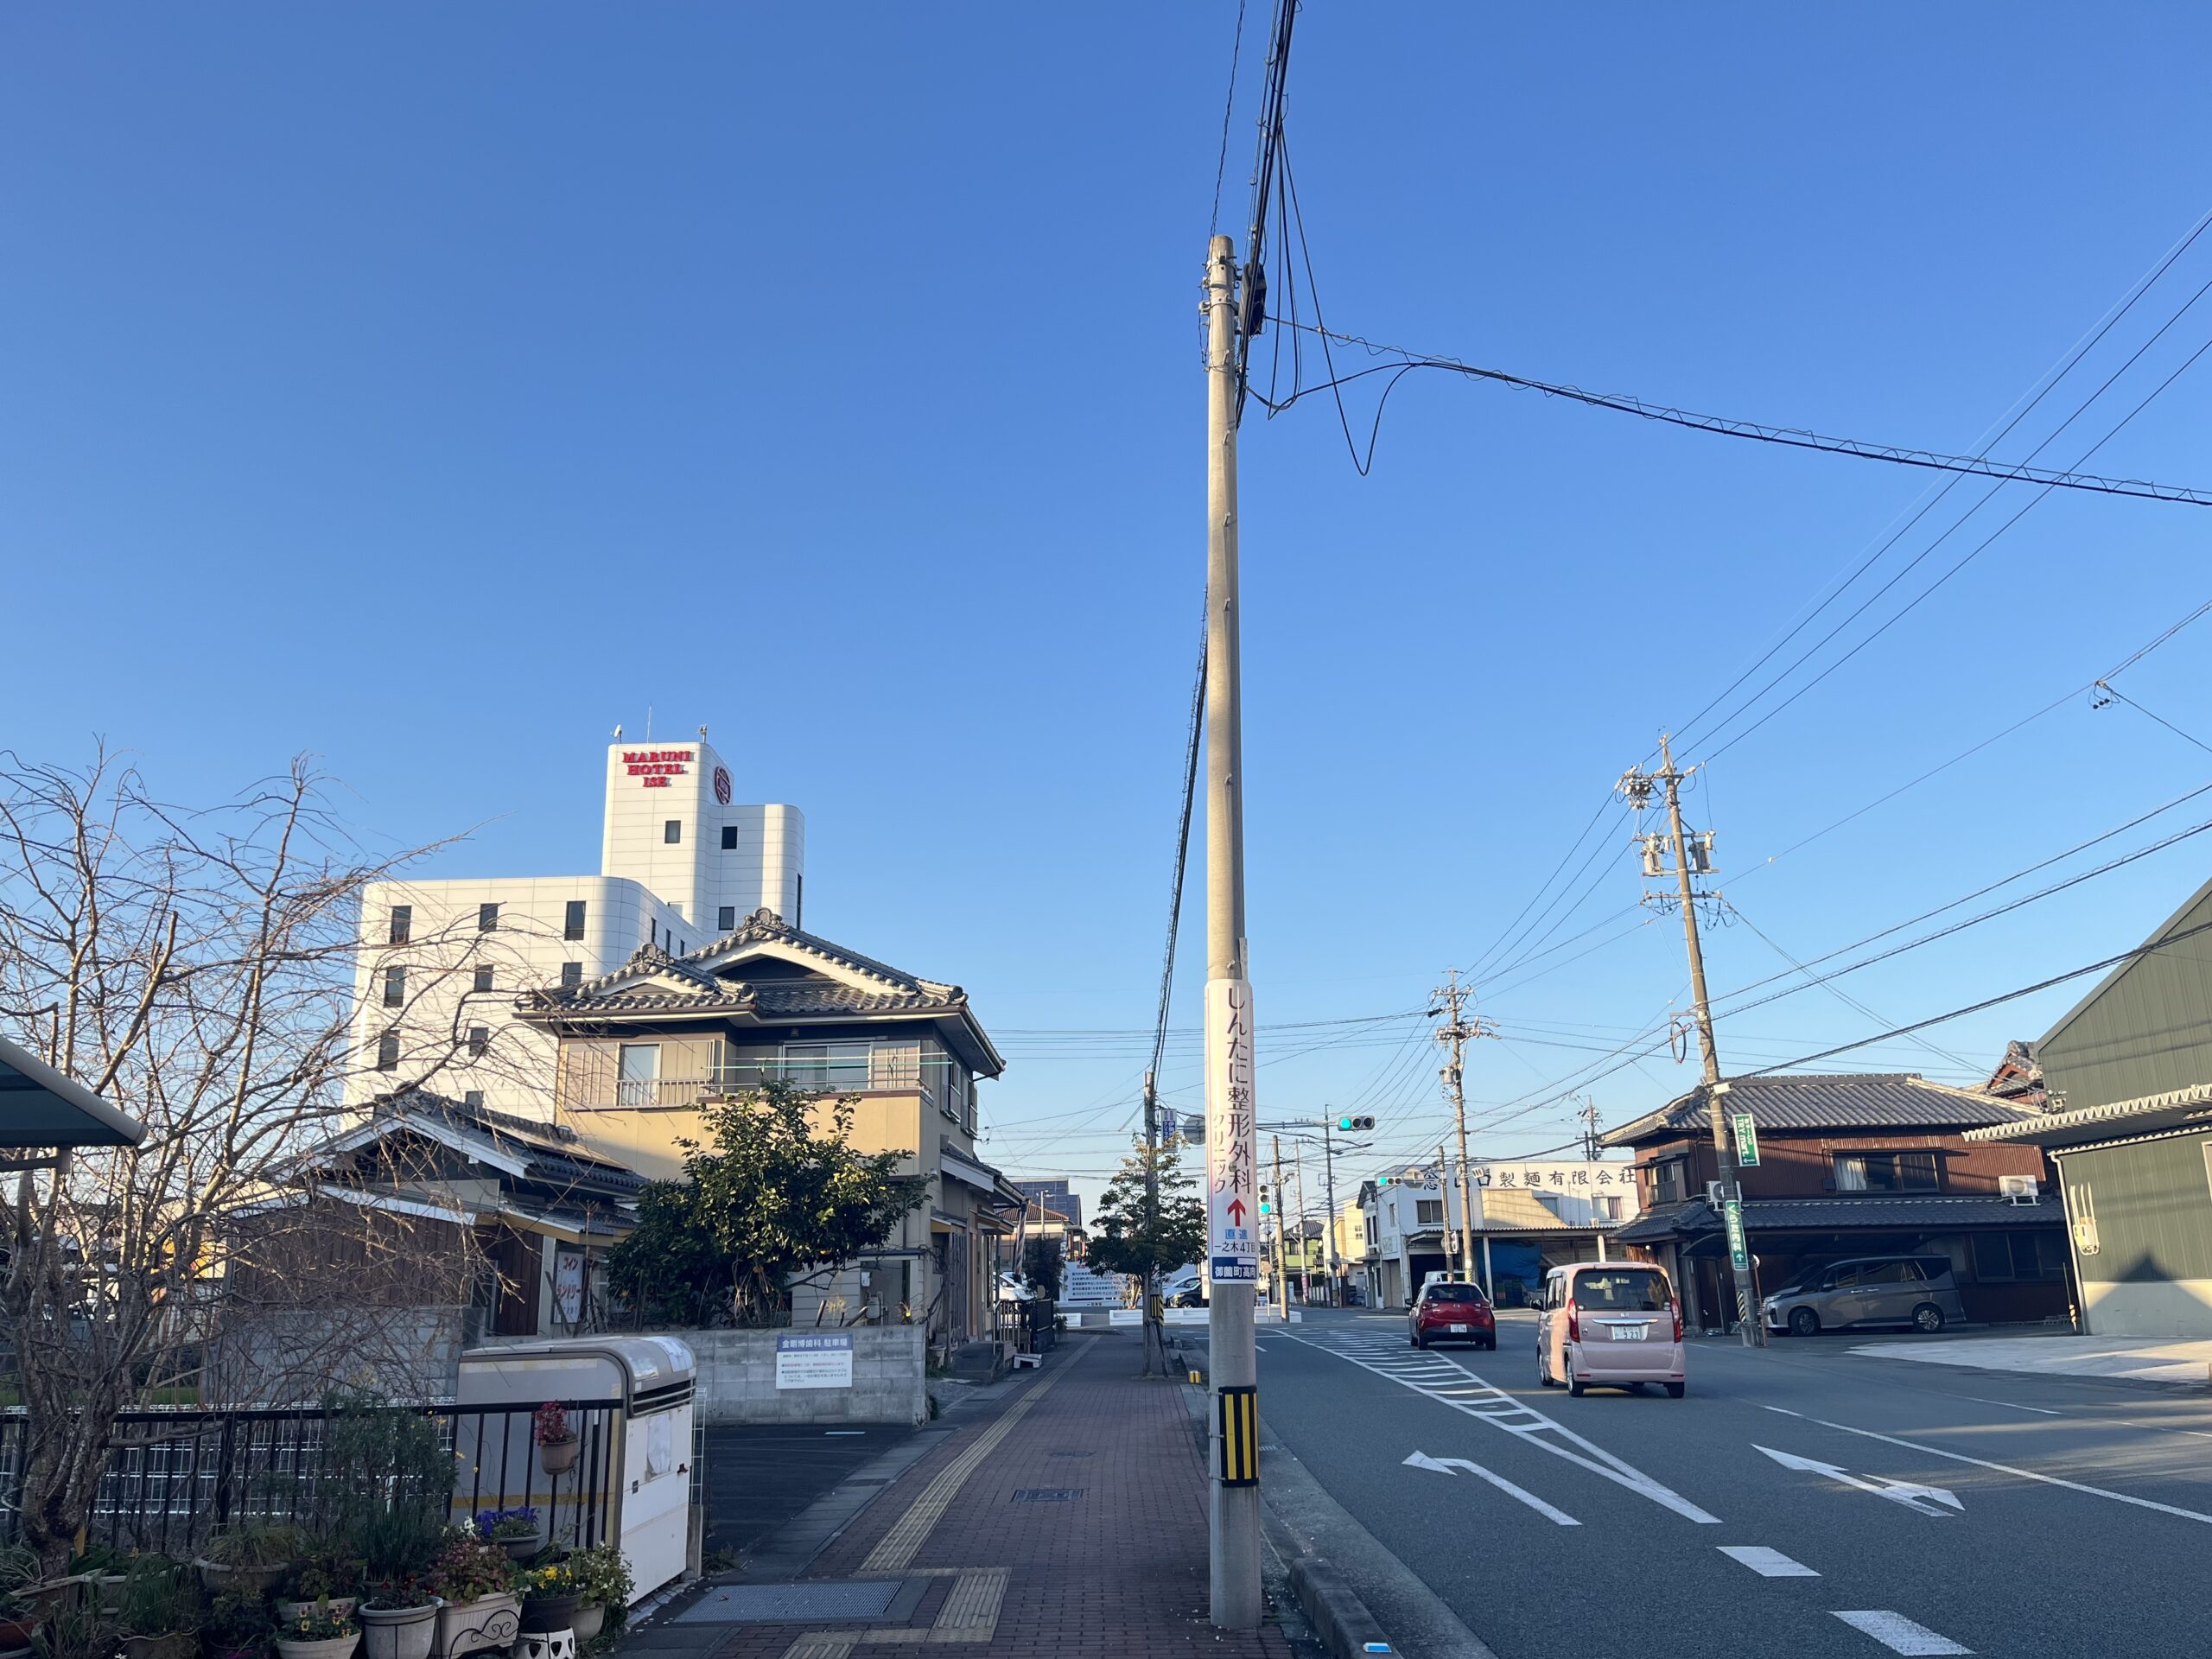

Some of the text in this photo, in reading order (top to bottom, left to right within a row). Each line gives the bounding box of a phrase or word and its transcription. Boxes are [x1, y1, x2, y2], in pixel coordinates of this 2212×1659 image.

[622, 751, 691, 763] MARUNI
[626, 764, 685, 775] HOTEL
[643, 776, 668, 788] ISE
[1226, 987, 1252, 1194] しんたに整形外科
[1737, 1118, 1745, 1134] TRY
[1213, 1113, 1227, 1194] クリニック
[1224, 1229, 1248, 1240] 直進
[1214, 1241, 1255, 1253] 一之木4丁目
[823, 1338, 848, 1347] 駐車場
